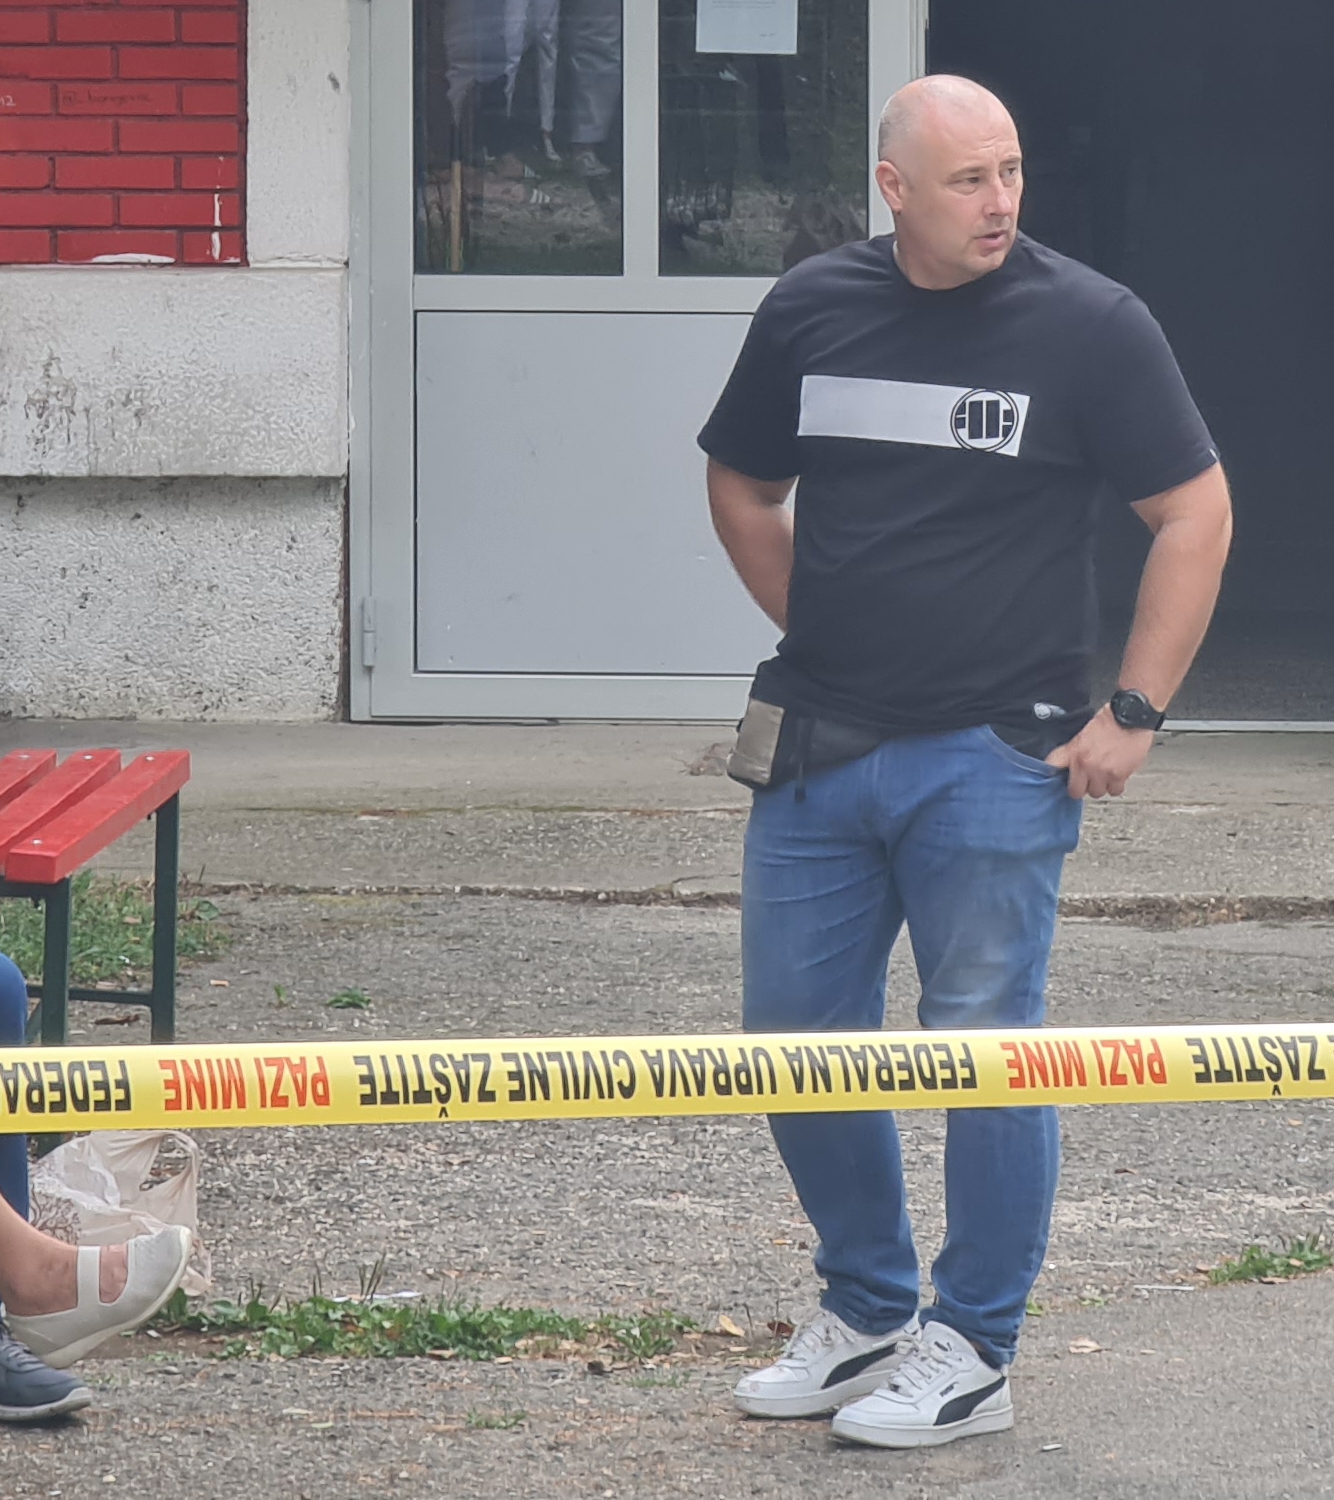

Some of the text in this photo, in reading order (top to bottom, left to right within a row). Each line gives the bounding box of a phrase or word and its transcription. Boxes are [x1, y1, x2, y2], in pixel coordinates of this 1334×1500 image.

[158, 1058, 247, 1112] MINE
[254, 1055, 332, 1109] PAZI
[353, 1053, 497, 1118] ZAŠTITE
[505, 1049, 637, 1102] CIVILNE
[641, 1048, 778, 1098] UPRAVA
[782, 1043, 978, 1094] FEDERALNA
[999, 1040, 1089, 1091] MINE
[1091, 1038, 1168, 1087] PAZI
[1187, 1036, 1326, 1095] ZAŠTITE
